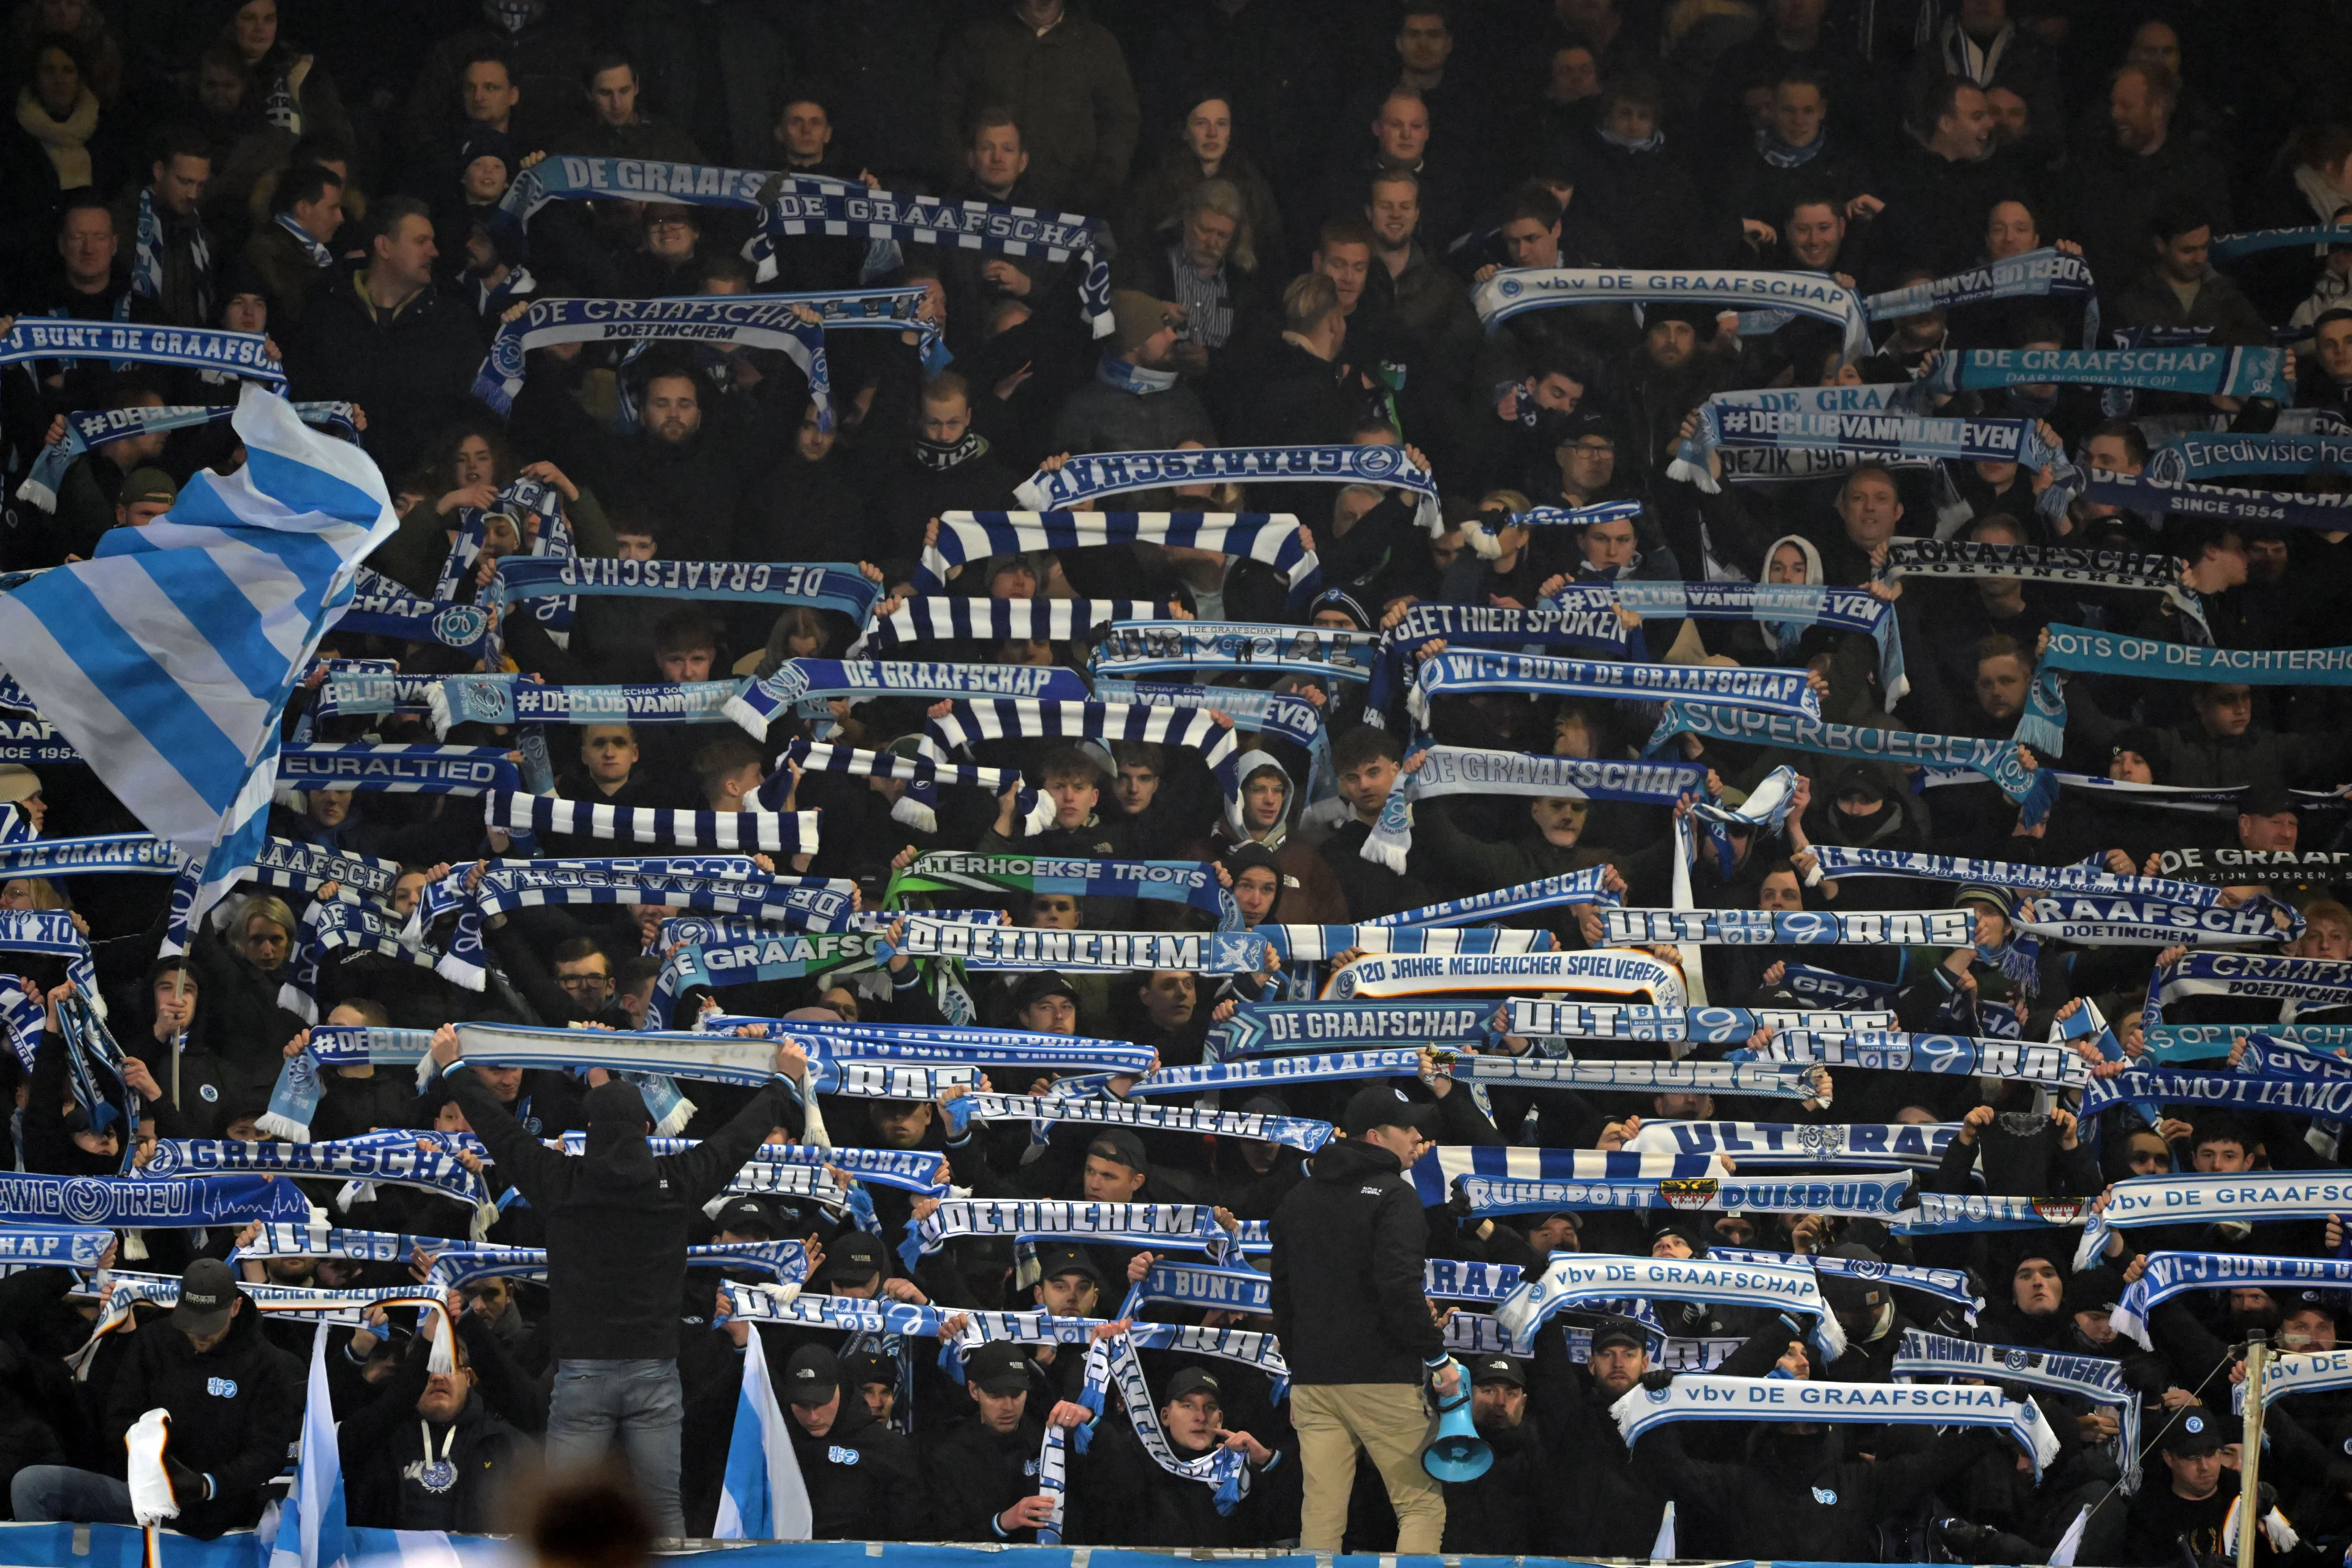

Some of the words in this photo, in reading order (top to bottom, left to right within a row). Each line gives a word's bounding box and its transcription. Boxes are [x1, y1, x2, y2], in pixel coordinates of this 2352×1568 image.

[563, 157, 609, 188] DE
[780, 194, 827, 219] DE
[846, 198, 1098, 251] GRAAFSCHA
[1537, 276, 1585, 290] vbv
[1599, 275, 1634, 290] DE
[1648, 274, 1845, 306] GRAAFSCHAP
[529, 302, 568, 327] DE
[32, 326, 103, 349] BUNT
[111, 330, 141, 351] DE
[603, 322, 738, 341] DOETINCHEM
[1975, 349, 2011, 367] DE
[2022, 350, 2216, 372] GRAAFSCHAP
[2123, 376, 2144, 385] WE
[1758, 392, 1801, 412] DE
[2184, 439, 2314, 468] Eredivisie
[2171, 497, 2230, 514] SINCE
[2234, 503, 2285, 520] 1954
[560, 557, 771, 593] GRAAFSCHAP
[785, 566, 826, 597] DE
[1905, 564, 2168, 588] DOETINCHEM
[1210, 627, 1277, 636] GRAAFSCHAP
[1395, 605, 1453, 641] GEET
[1460, 606, 1520, 632] HIER
[2119, 639, 2158, 661] OP
[2165, 644, 2202, 666] DE
[840, 660, 876, 688] DE
[880, 660, 1052, 697] GRAAFSCHAP
[1448, 655, 1512, 680] WI-J
[1519, 657, 1583, 683] BUNT
[1594, 664, 1624, 685] DE
[1634, 668, 1798, 702] GRAAFSCHAP
[1683, 702, 2006, 768] SUPERBOEREN
[38, 747, 83, 760] 1954
[285, 756, 496, 783] EURALTIED
[1417, 752, 1457, 787] DE
[1463, 753, 1700, 797] GRAAFSCHAP
[19, 846, 49, 867] DE
[2160, 848, 2204, 875] DE
[1113, 864, 1207, 888] TROTS
[1857, 848, 1917, 869] OOK
[1927, 854, 1957, 870] IN
[2114, 873, 2222, 907] TIJDEN
[2209, 872, 2247, 881] ZIJN
[784, 886, 851, 920] DE
[1608, 910, 1712, 943] ULT
[1844, 912, 1970, 944] RAS
[2063, 925, 2199, 944] DOETINCHEM
[907, 919, 1202, 971] DOETINCHEM
[655, 951, 697, 998] DE
[1356, 960, 1386, 984] 120
[1392, 956, 1444, 979] JAHRE
[1449, 954, 1561, 976] MEIDERICHER
[1567, 956, 1670, 989] SPIELVEREIN
[1269, 1012, 1302, 1041] DE
[1306, 1010, 1477, 1039] GRAAFSCHAP
[1513, 1000, 1623, 1037] ULT
[2177, 1027, 2223, 1044] OP
[848, 1063, 977, 1100] RAS
[1225, 1061, 1261, 1080] DE
[979, 1093, 1267, 1137] DOETINCHEM
[1670, 1121, 1796, 1155] ULT
[755, 1144, 933, 1178] GRAAFSCHAP
[111, 1182, 191, 1216] TREU
[1465, 1177, 1659, 1211] RUHRPOTT
[2107, 1194, 2152, 1212] vbv
[2166, 1190, 2202, 1206] DE
[920, 1201, 1198, 1245] DOETINCHEM
[1175, 1272, 1245, 1303] BUNT
[1556, 1267, 1596, 1286] vbv
[1606, 1265, 1636, 1281] DE
[1648, 1265, 1815, 1298] GRAAFSCHAP
[2147, 1257, 2207, 1287] WI-J
[2217, 1257, 2285, 1278] BUNT
[2294, 1262, 2324, 1278] DE
[109, 1286, 133, 1312] 120
[1924, 1335, 1987, 1365] HEIMAT
[2045, 1354, 2115, 1388] UNSER
[2313, 1353, 2349, 1373] DE
[1686, 1385, 1736, 1402] vbv
[1749, 1386, 1784, 1403] DE
